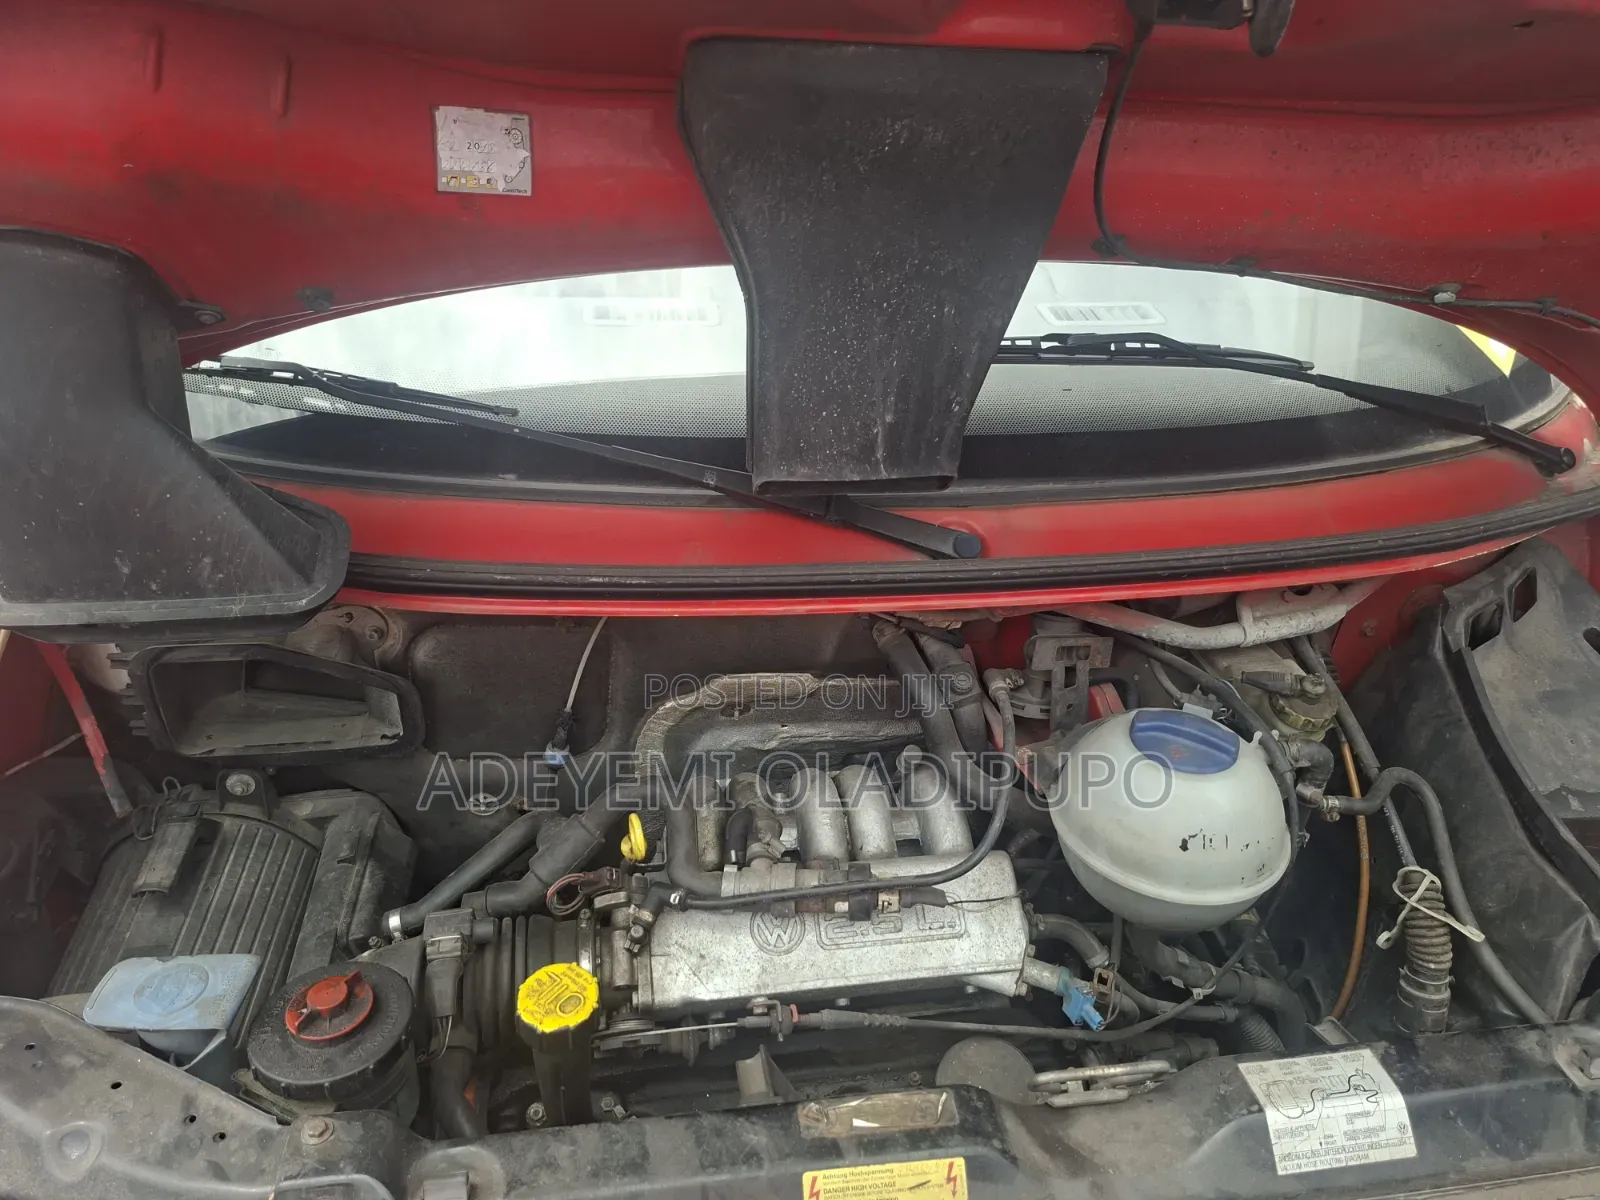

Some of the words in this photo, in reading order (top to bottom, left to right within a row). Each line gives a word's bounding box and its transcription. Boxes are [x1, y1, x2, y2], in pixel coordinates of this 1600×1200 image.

[538, 971, 585, 1018] OIL
[1280, 1162, 1302, 1172] VACUUM
[1304, 1160, 1318, 1169] HOSE
[1320, 1156, 1343, 1167] ROUTING
[1345, 1153, 1369, 1164] DIAGRAM
[822, 1171, 847, 1181] Achtung
[823, 1185, 850, 1195] DANGER
[851, 1184, 867, 1192] HIGH
[867, 1181, 896, 1190] VOLTAGE
